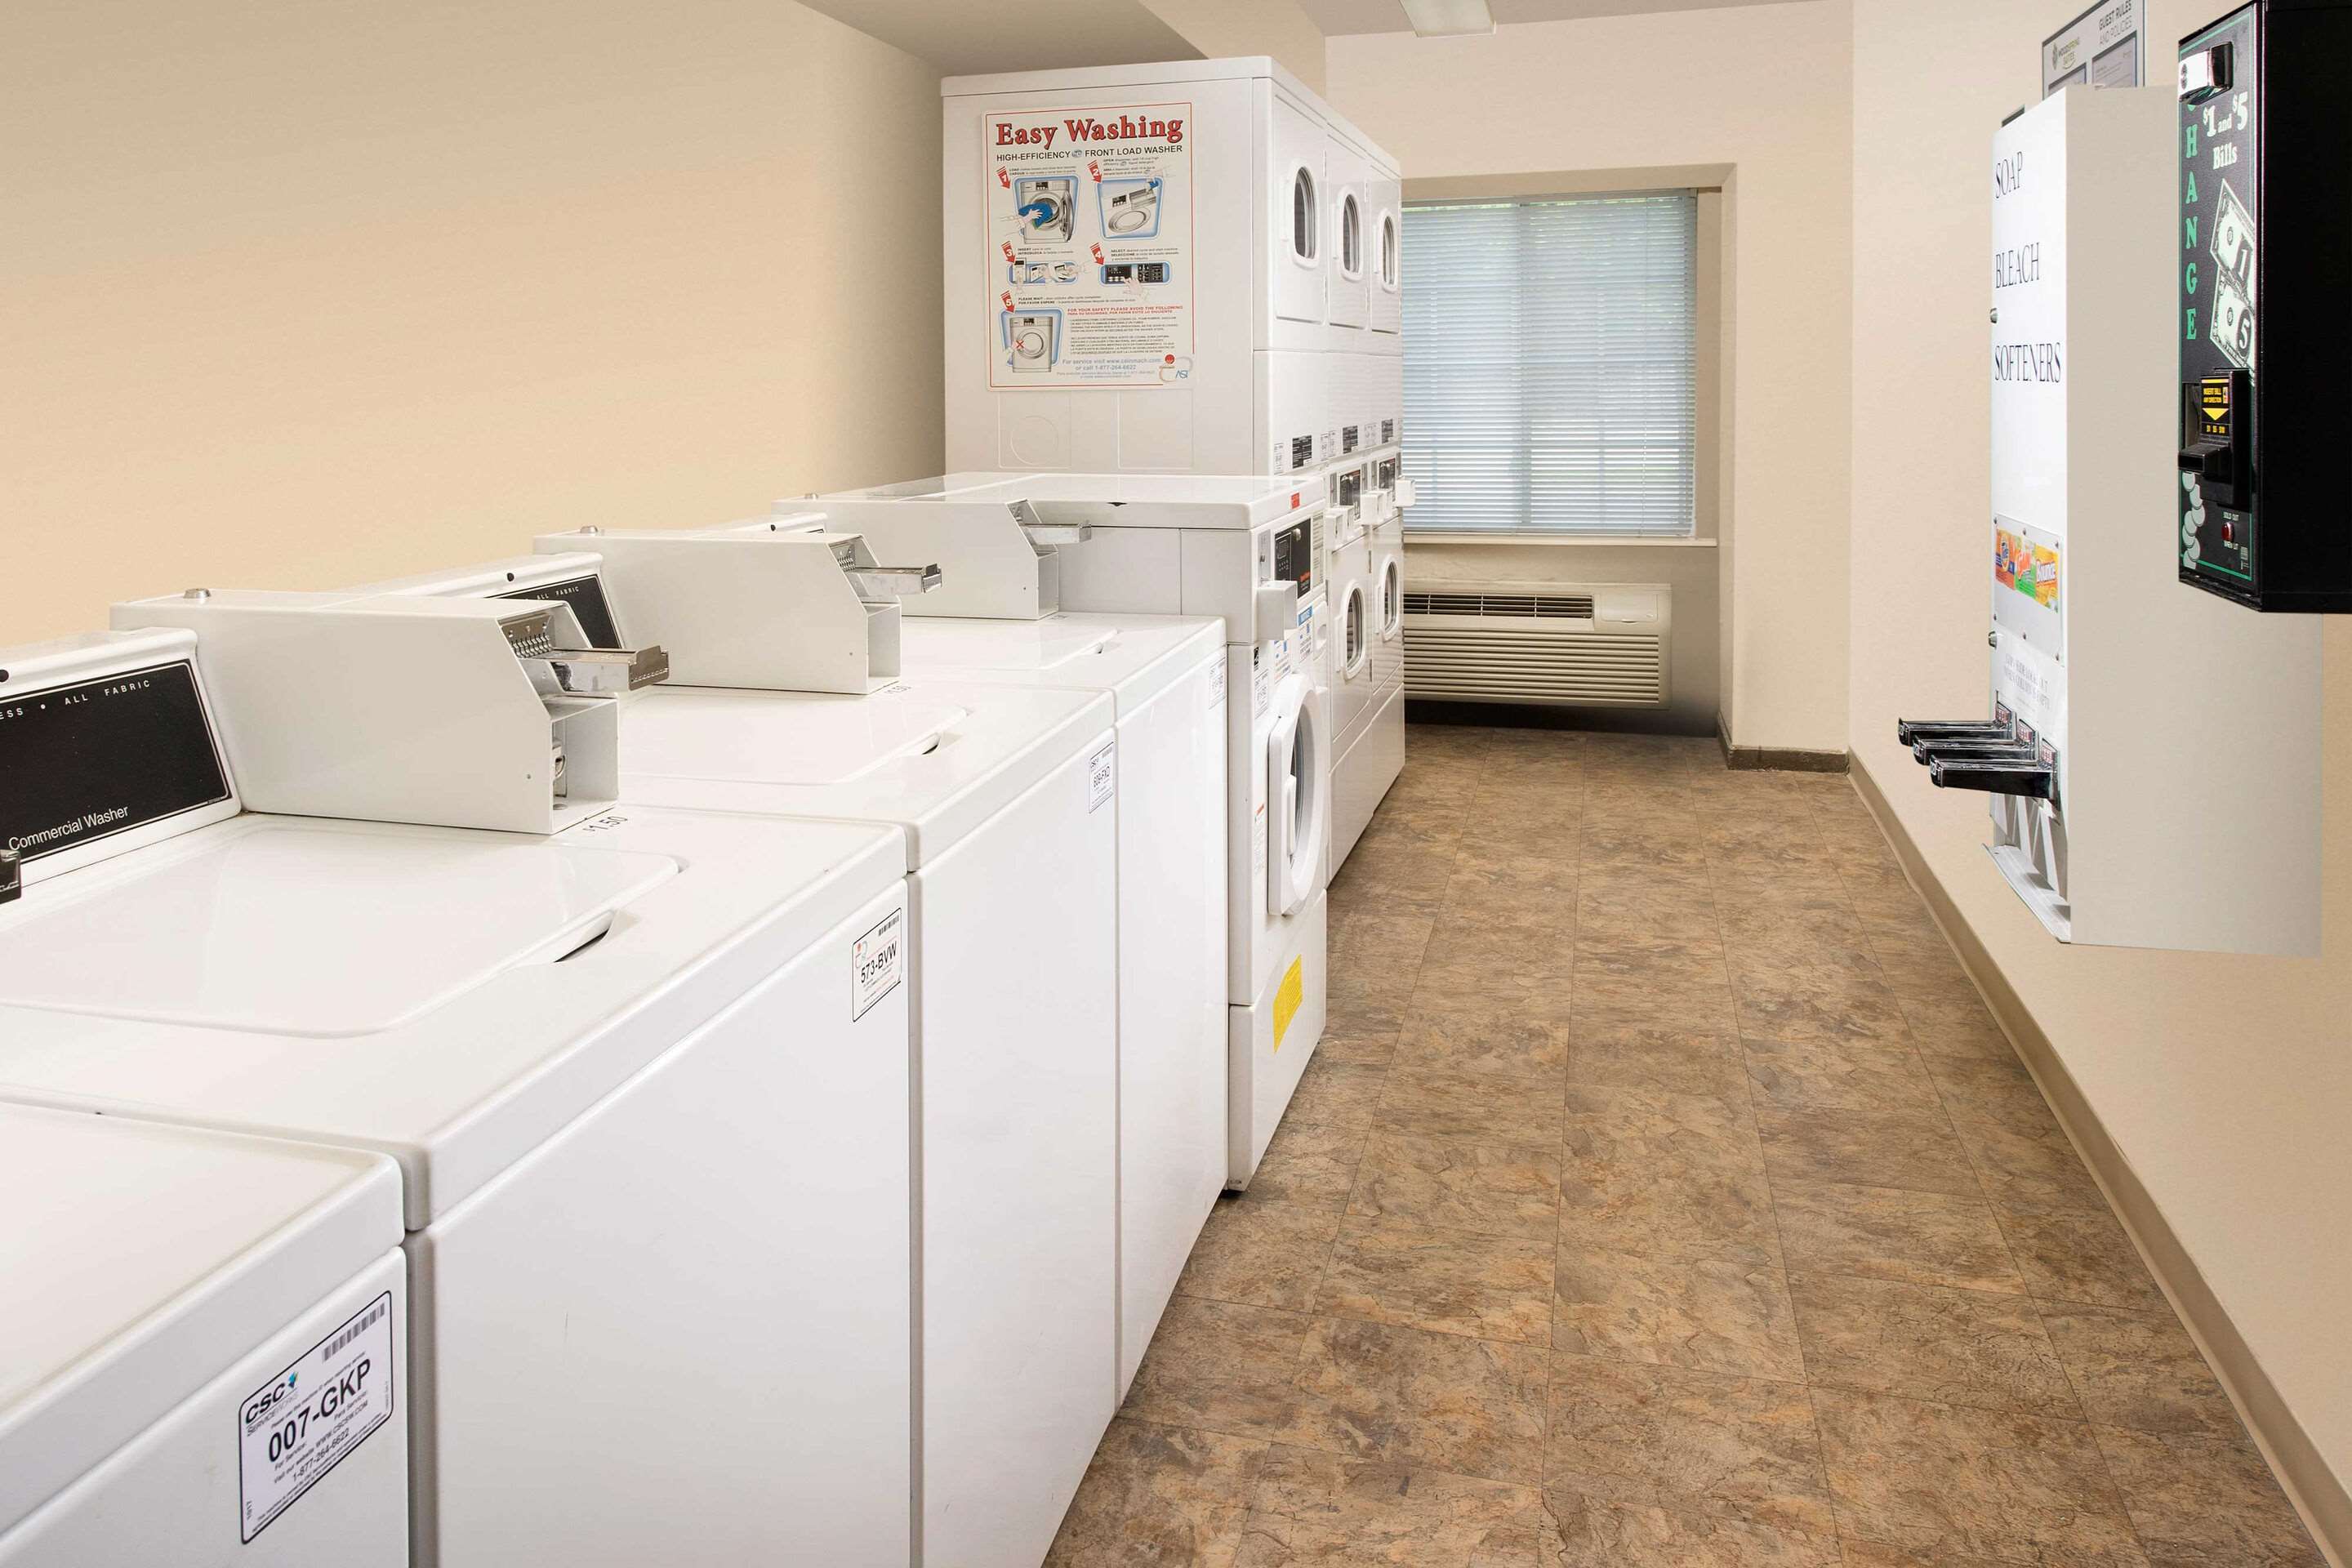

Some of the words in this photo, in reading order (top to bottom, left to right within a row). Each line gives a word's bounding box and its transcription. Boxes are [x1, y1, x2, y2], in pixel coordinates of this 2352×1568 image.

[996, 122, 1058, 150] Easy
[1064, 115, 1183, 143] Washing
[2203, 105, 2216, 137] $1
[2218, 113, 2232, 133] and
[2233, 91, 2248, 131] $5
[996, 150, 1071, 162] HIGH-EFFICIENCY
[1085, 149, 1114, 157] FRONT
[1116, 147, 1142, 155] LOAD
[1145, 145, 1183, 154] WASHER
[2212, 142, 2237, 170] Bills
[1995, 151, 2024, 199] SOAP
[2185, 104, 2198, 340] HANGE
[1995, 242, 2040, 289] BLEACH
[1994, 342, 2061, 383] SOFTENERS
[555, 586, 579, 596] FABRIC
[65, 694, 88, 706] ALL
[105, 679, 151, 697] FABRIC
[8, 817, 83, 851] Commercial
[83, 805, 129, 828] Washer
[861, 941, 898, 983] 573-BVW
[246, 1383, 285, 1424] CSC
[269, 1358, 371, 1463] 007-GKP
